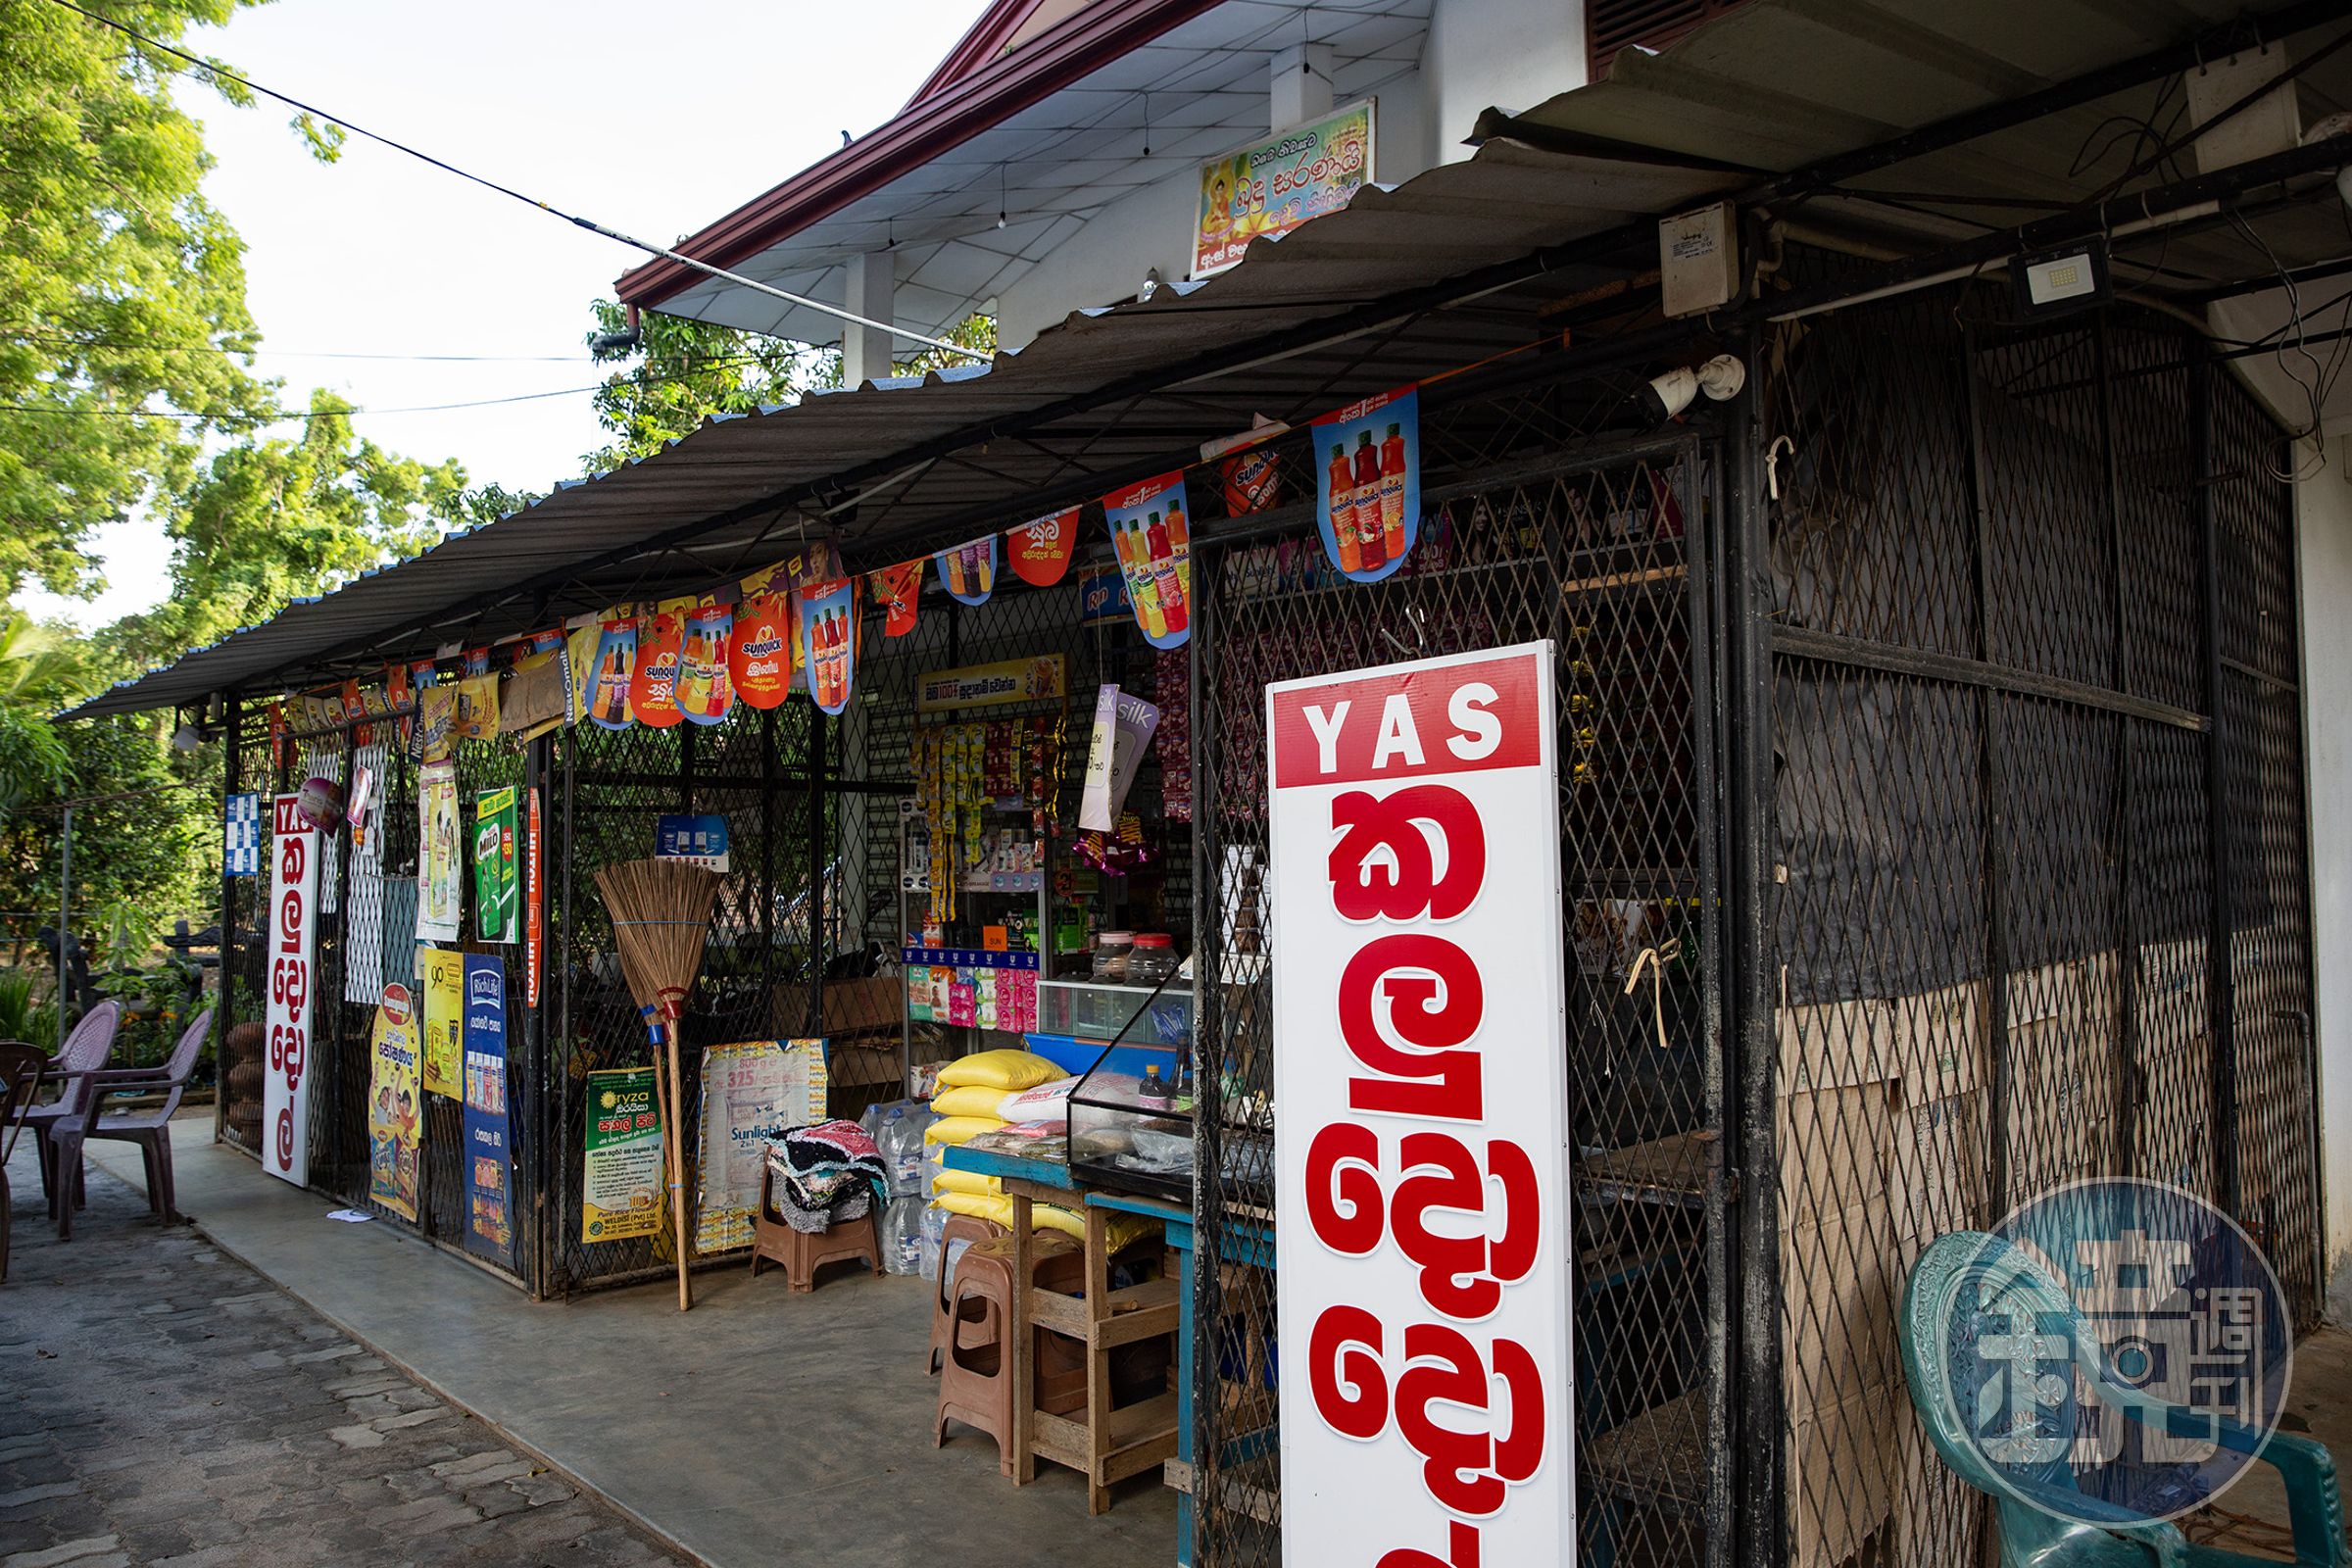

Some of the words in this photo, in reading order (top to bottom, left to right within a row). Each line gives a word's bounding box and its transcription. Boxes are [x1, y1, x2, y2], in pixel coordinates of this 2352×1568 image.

[1234, 176, 1267, 220] බුදු
[1273, 140, 1362, 196] සරණයි
[742, 639, 782, 656] SUNQUICK
[645, 666, 676, 680] SUNQU
[746, 661, 780, 677] இனிய
[1117, 702, 1153, 729] silk
[1301, 682, 1503, 774] YAS
[279, 804, 308, 832] YA
[479, 833, 498, 857] MILO
[473, 977, 499, 997] RichLife
